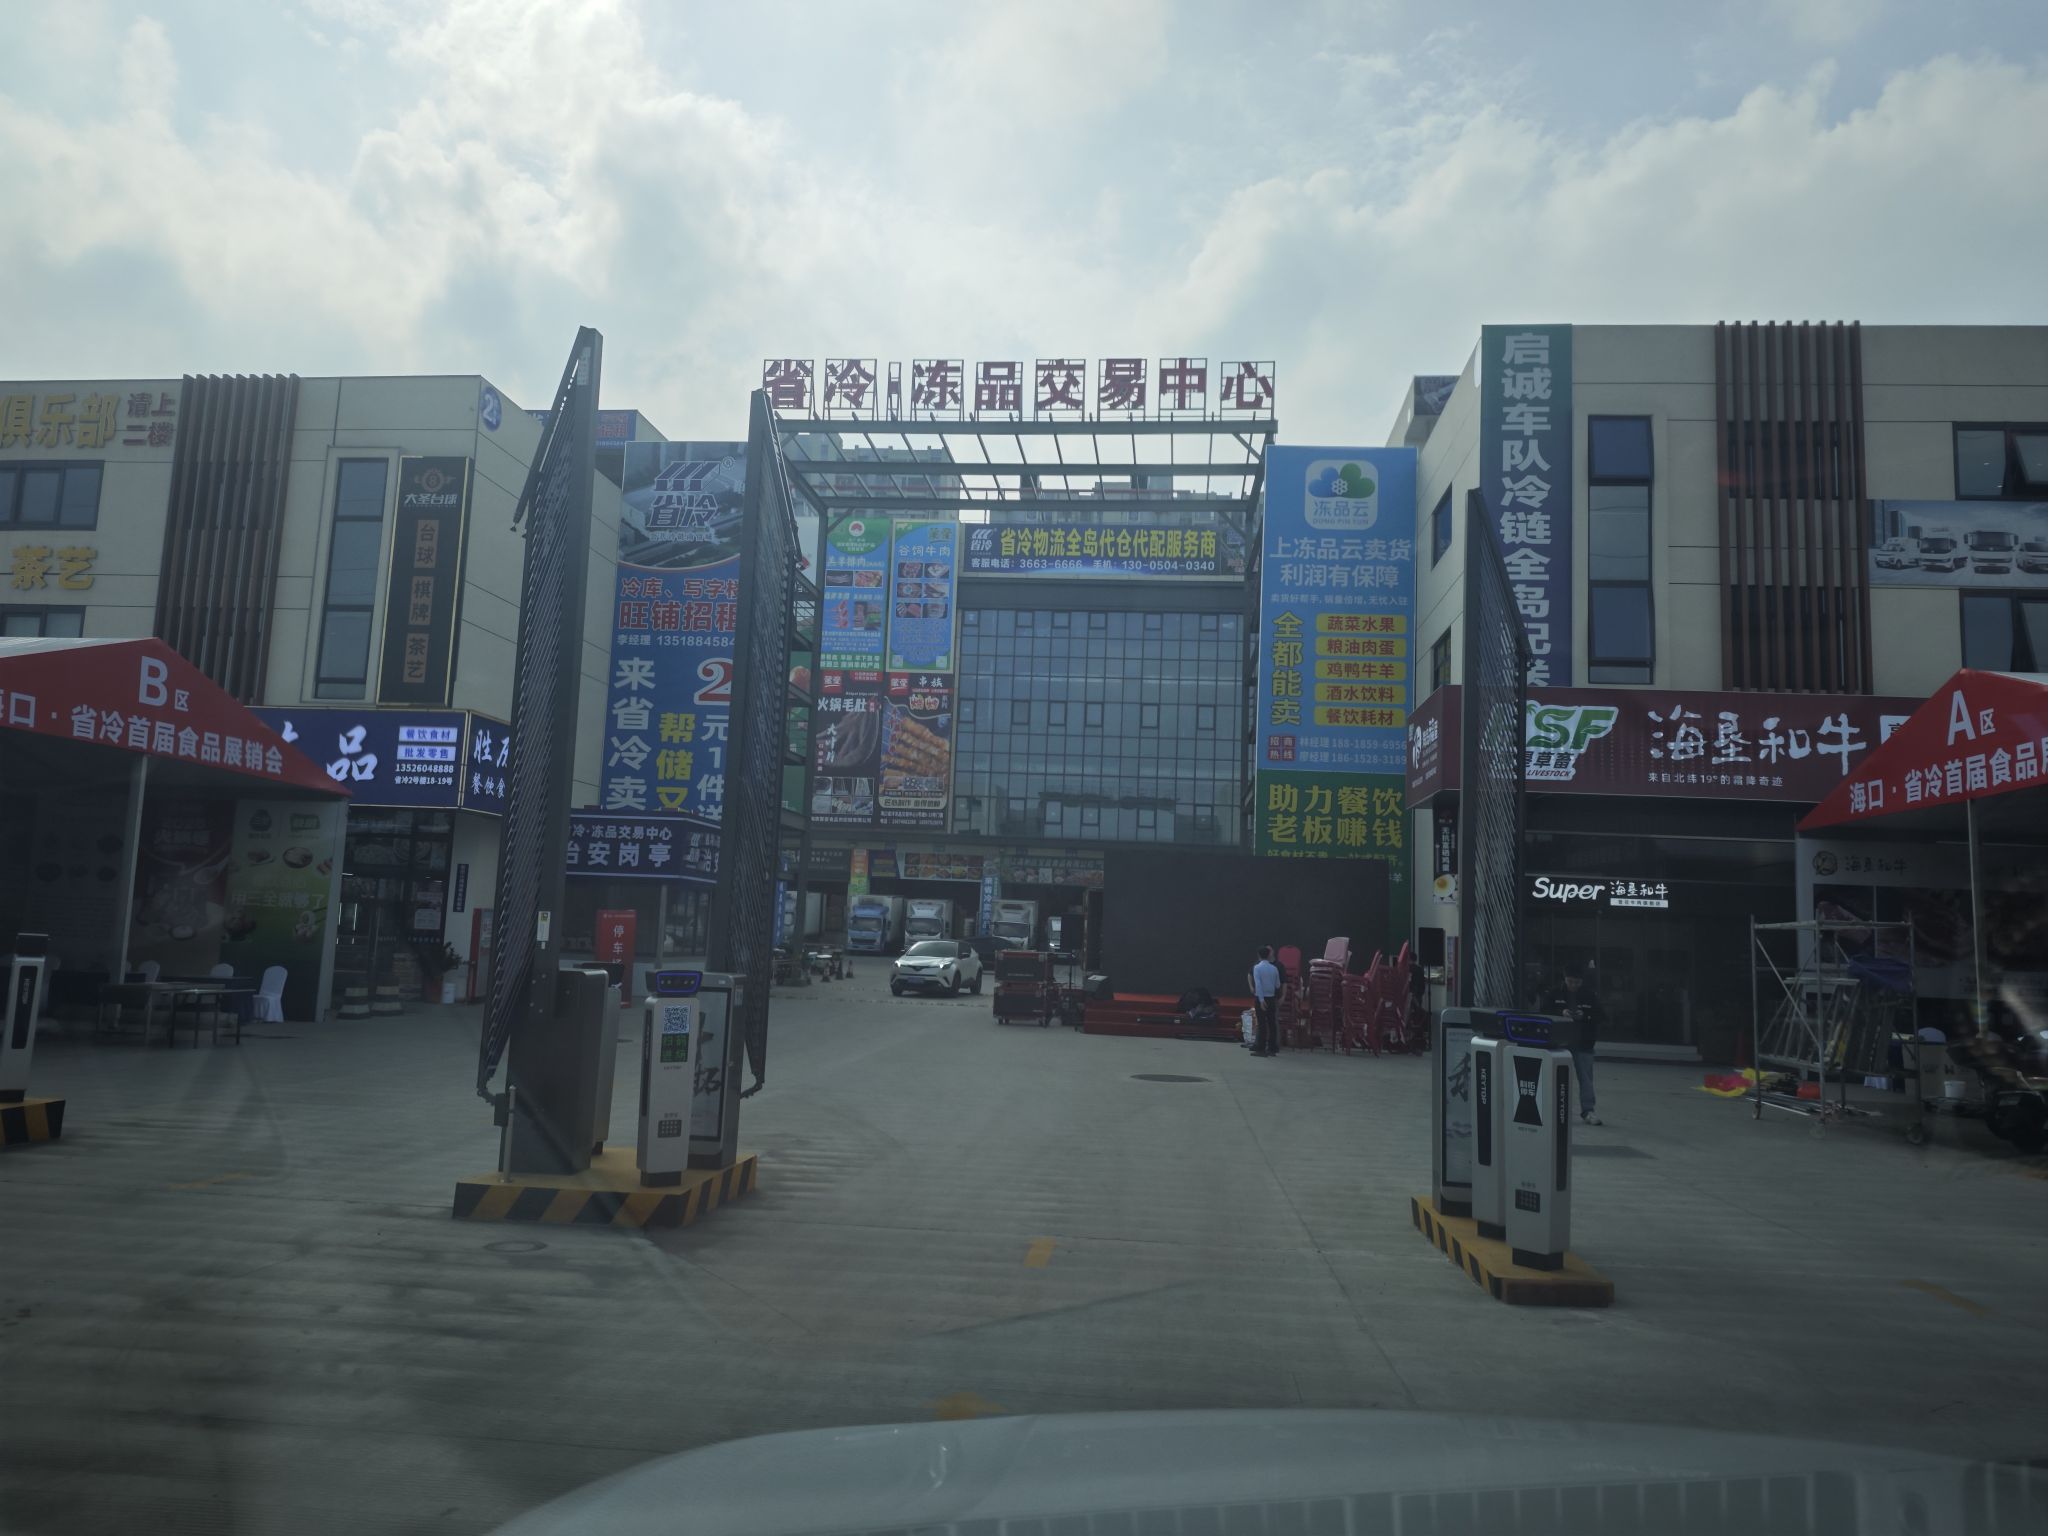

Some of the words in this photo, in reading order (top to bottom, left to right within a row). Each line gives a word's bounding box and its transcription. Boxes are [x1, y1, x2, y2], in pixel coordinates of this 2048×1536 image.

[128, 393, 176, 417] 请上
[0, 393, 120, 448] 俱乐部
[123, 421, 174, 447] 二楼
[404, 493, 458, 505] 大圣台球
[1313, 501, 1368, 517] 冻品云
[416, 523, 436, 564] 台球
[898, 545, 951, 557] 谷饲牛肉
[970, 539, 992, 551] 省冷
[1000, 527, 1216, 558] 省冷物流全岛代仓代配服务商
[1269, 536, 1412, 561] 上冻品云卖货
[11, 546, 97, 590] 茶艺
[1019, 559, 1083, 569] 3663-6666
[1121, 560, 1215, 571] 130-0504-0340
[1280, 563, 1399, 588] 利润有保障
[411, 580, 432, 622] 棋牌
[619, 601, 737, 632] 旺铺招租
[1327, 616, 1395, 632] 蔬菜水果
[407, 637, 427, 679] 茶艺
[1327, 639, 1395, 656] 粮油肉蛋
[1272, 610, 1304, 726] 全都能卖
[1327, 662, 1395, 678] 鸡鸭牛羊
[139, 655, 190, 711] B区
[1326, 685, 1394, 702] 酒水饮料
[817, 697, 867, 712] 火锅毛肚
[1326, 708, 1394, 726] 餐饮耗材
[1947, 690, 1996, 745] A区
[406, 729, 451, 740] 餐饮食材
[1270, 736, 1294, 747] 招商
[1648, 704, 1867, 776] 海垦和牛
[404, 748, 450, 759] 批发零售
[1270, 750, 1294, 760] 热线
[395, 763, 454, 774] 13526048888
[1527, 769, 1572, 777] LIVESTOCK
[1849, 735, 2048, 814] 海口·省冷首届食品
[1267, 783, 1403, 817] 助力餐饮
[569, 823, 672, 841] 冷·冻品交易中心
[1267, 813, 1403, 849] 老板赚钱
[1532, 876, 1606, 903] Super
[1610, 880, 1669, 899] 海垦和牛
